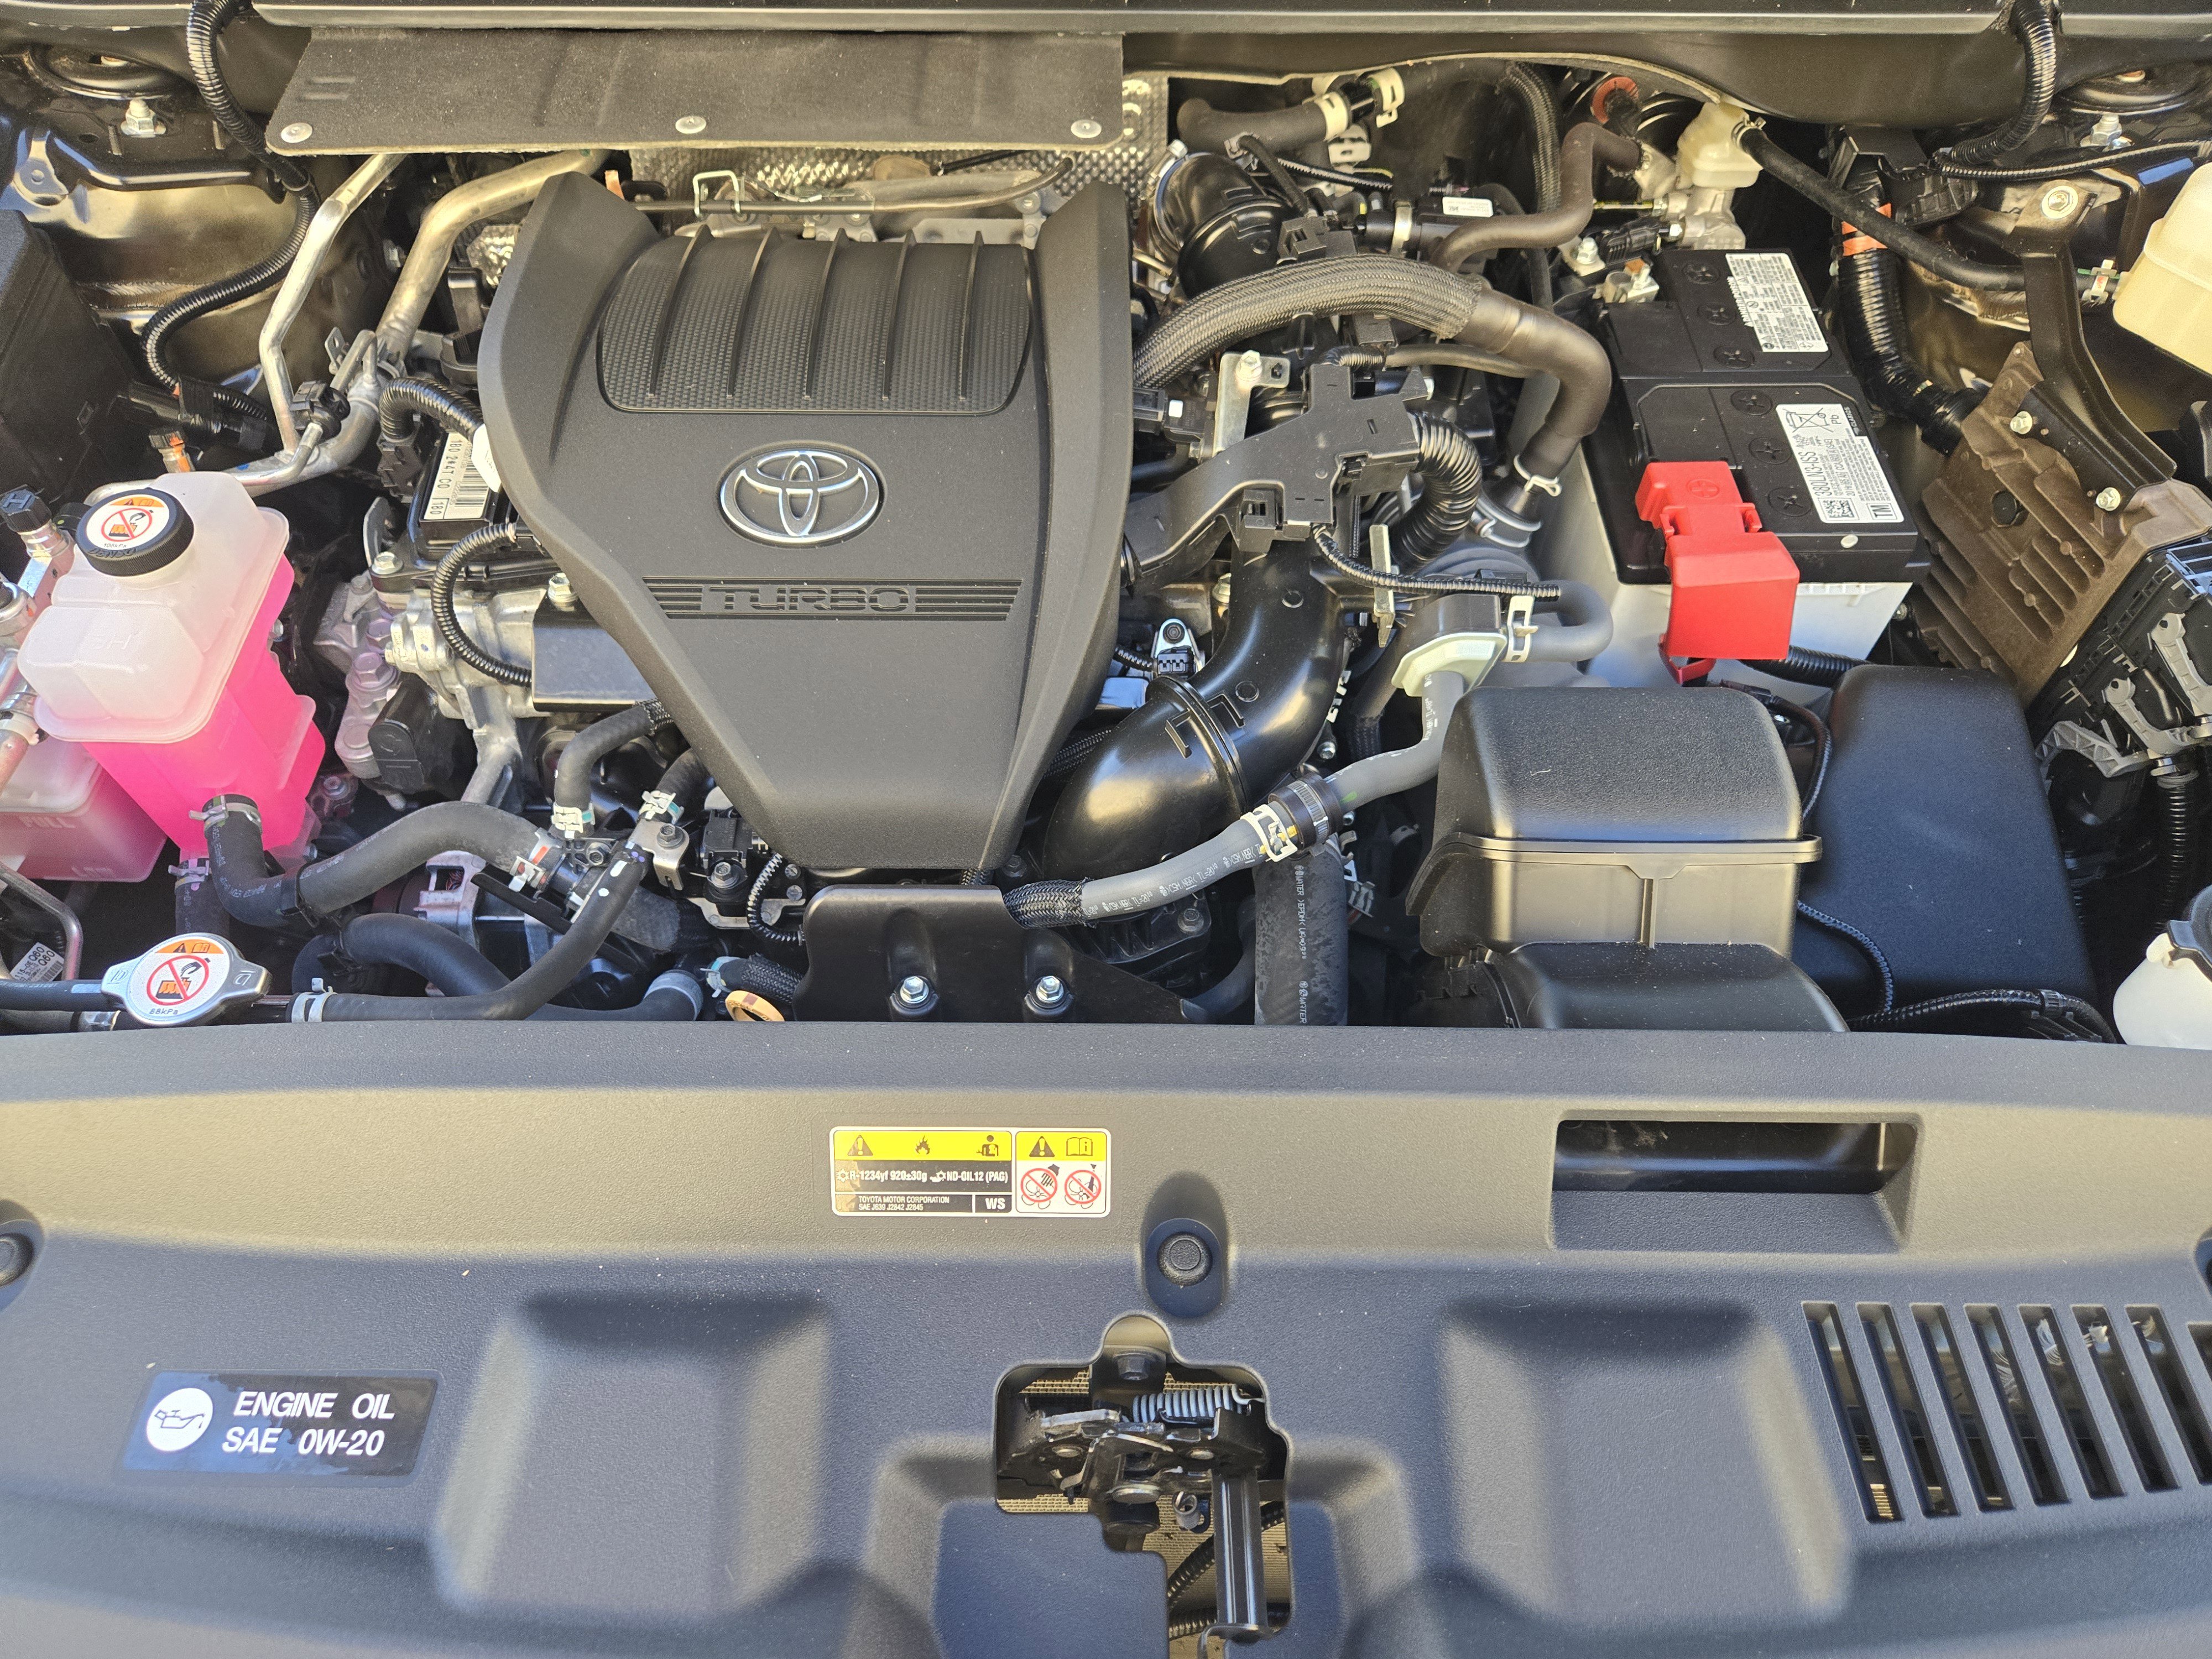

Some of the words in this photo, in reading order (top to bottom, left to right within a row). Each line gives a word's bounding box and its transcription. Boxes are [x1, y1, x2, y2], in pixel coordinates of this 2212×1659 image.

[1829, 414, 1842, 425] Pb
[448, 440, 463, 452] 180
[1798, 451, 1832, 497] 380LN3-ISS
[3, 493, 32, 509] H
[430, 502, 445, 515] 180
[1870, 505, 1893, 518] TM
[706, 585, 910, 612] TURBO
[849, 1170, 889, 1182] R-1234yf
[890, 1170, 927, 1183] 920±30g
[946, 1170, 984, 1182] ND-OIL12
[985, 1170, 1009, 1183] (PAG)
[984, 1197, 1006, 1210] WS
[233, 1390, 339, 1419] ENGINE
[352, 1393, 395, 1420] OIL
[222, 1426, 283, 1454] SAE
[298, 1428, 385, 1456] 0W-20
